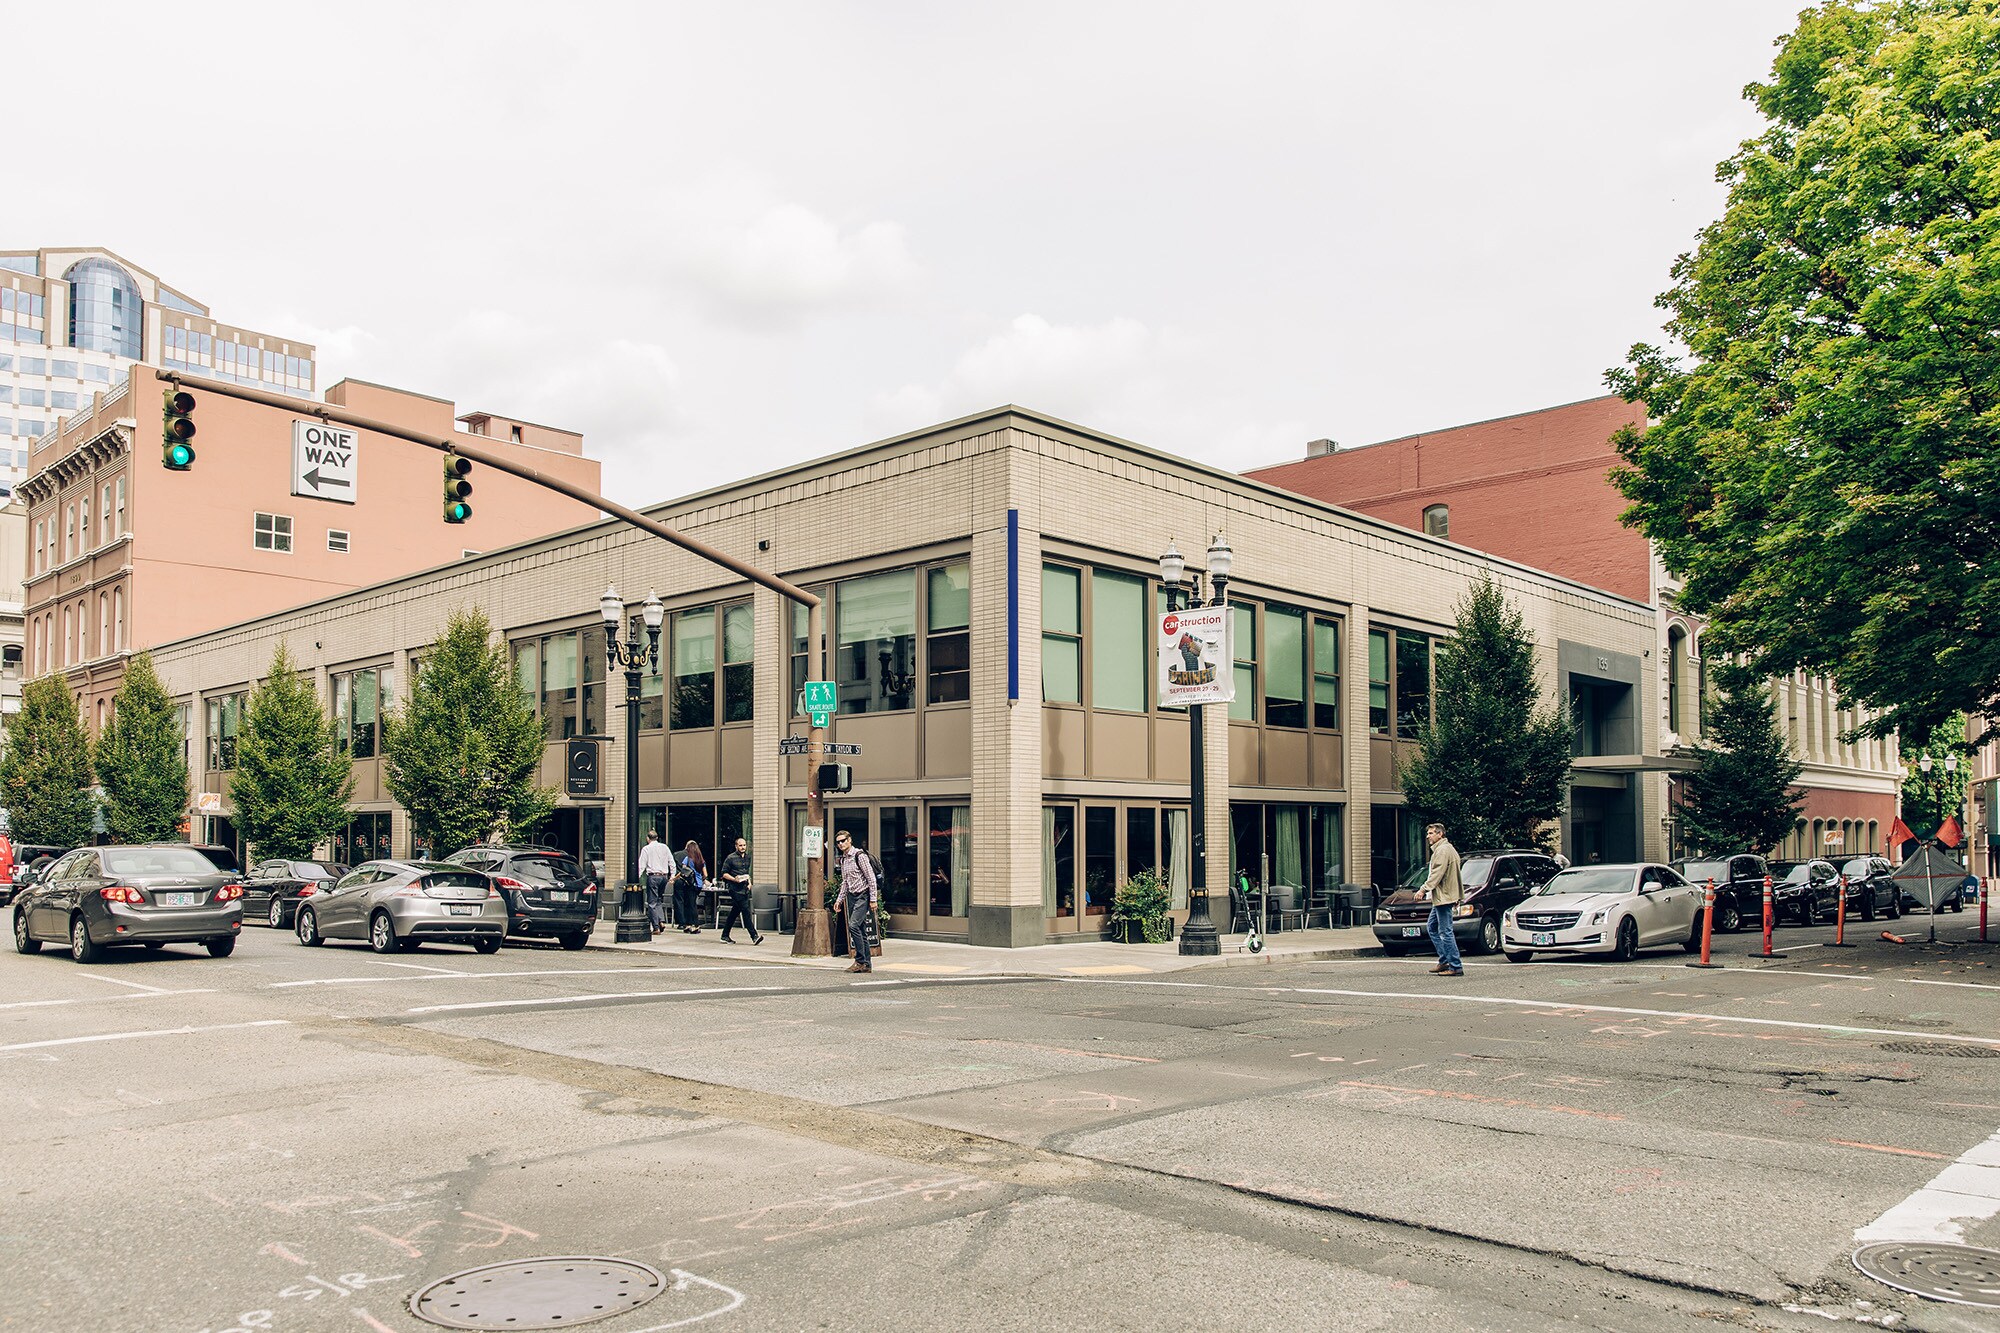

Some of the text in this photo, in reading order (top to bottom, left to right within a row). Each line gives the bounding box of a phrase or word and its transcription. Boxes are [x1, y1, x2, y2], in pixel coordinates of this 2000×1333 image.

[306, 427, 351, 450] ONE
[305, 446, 352, 468] WAY
[1169, 686, 1201, 694] SEPTEMBER
[824, 744, 861, 754] SW TAYLOR ST
[573, 750, 593, 772] Q
